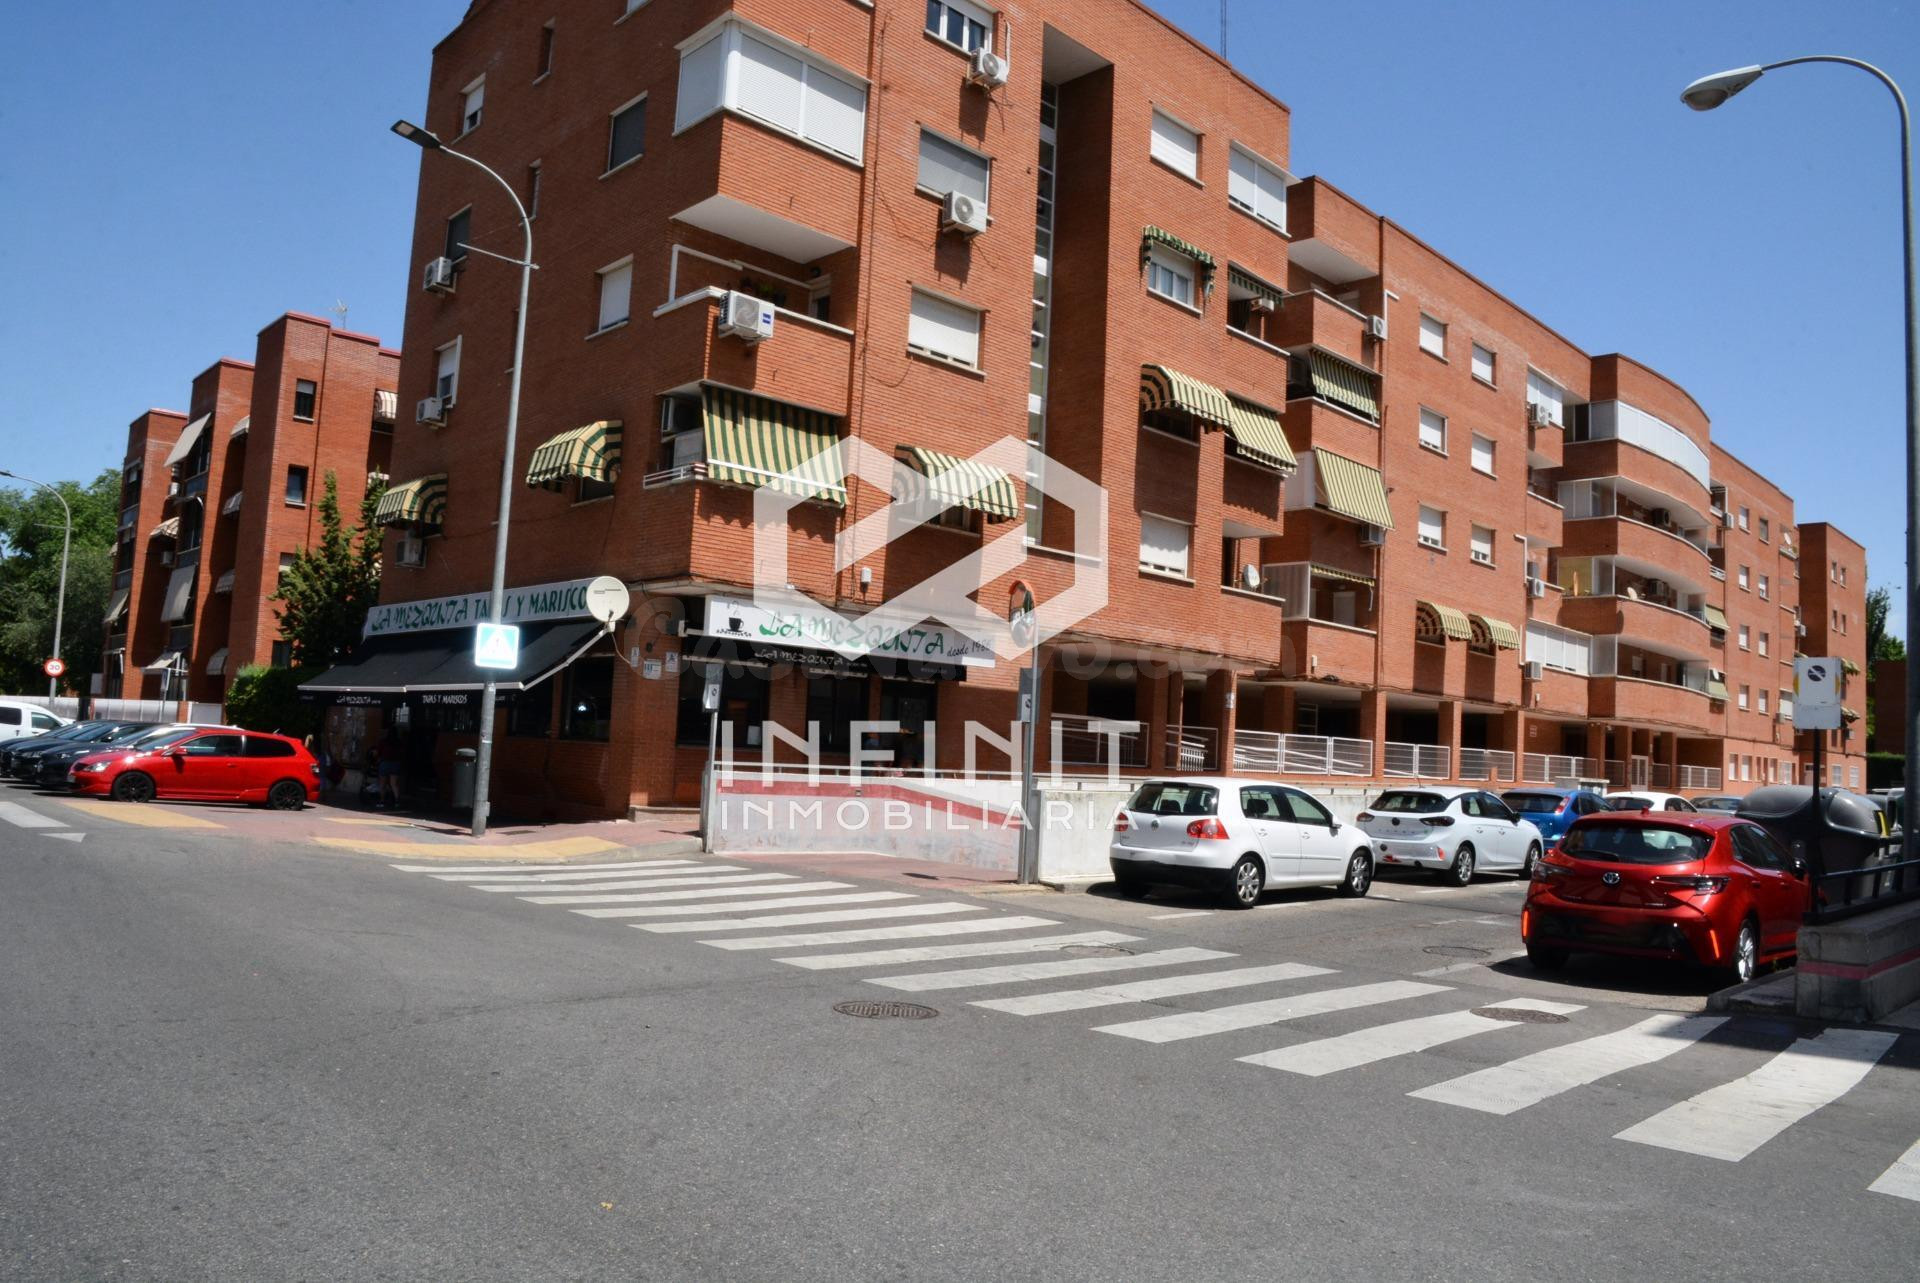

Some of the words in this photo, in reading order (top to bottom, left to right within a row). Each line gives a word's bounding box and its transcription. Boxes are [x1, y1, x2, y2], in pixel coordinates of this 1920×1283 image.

[475, 598, 511, 619] TAS
[516, 595, 526, 616] Y
[759, 611, 803, 637] LA
[808, 615, 944, 655] MEZQUITA
[947, 643, 969, 657] desde
